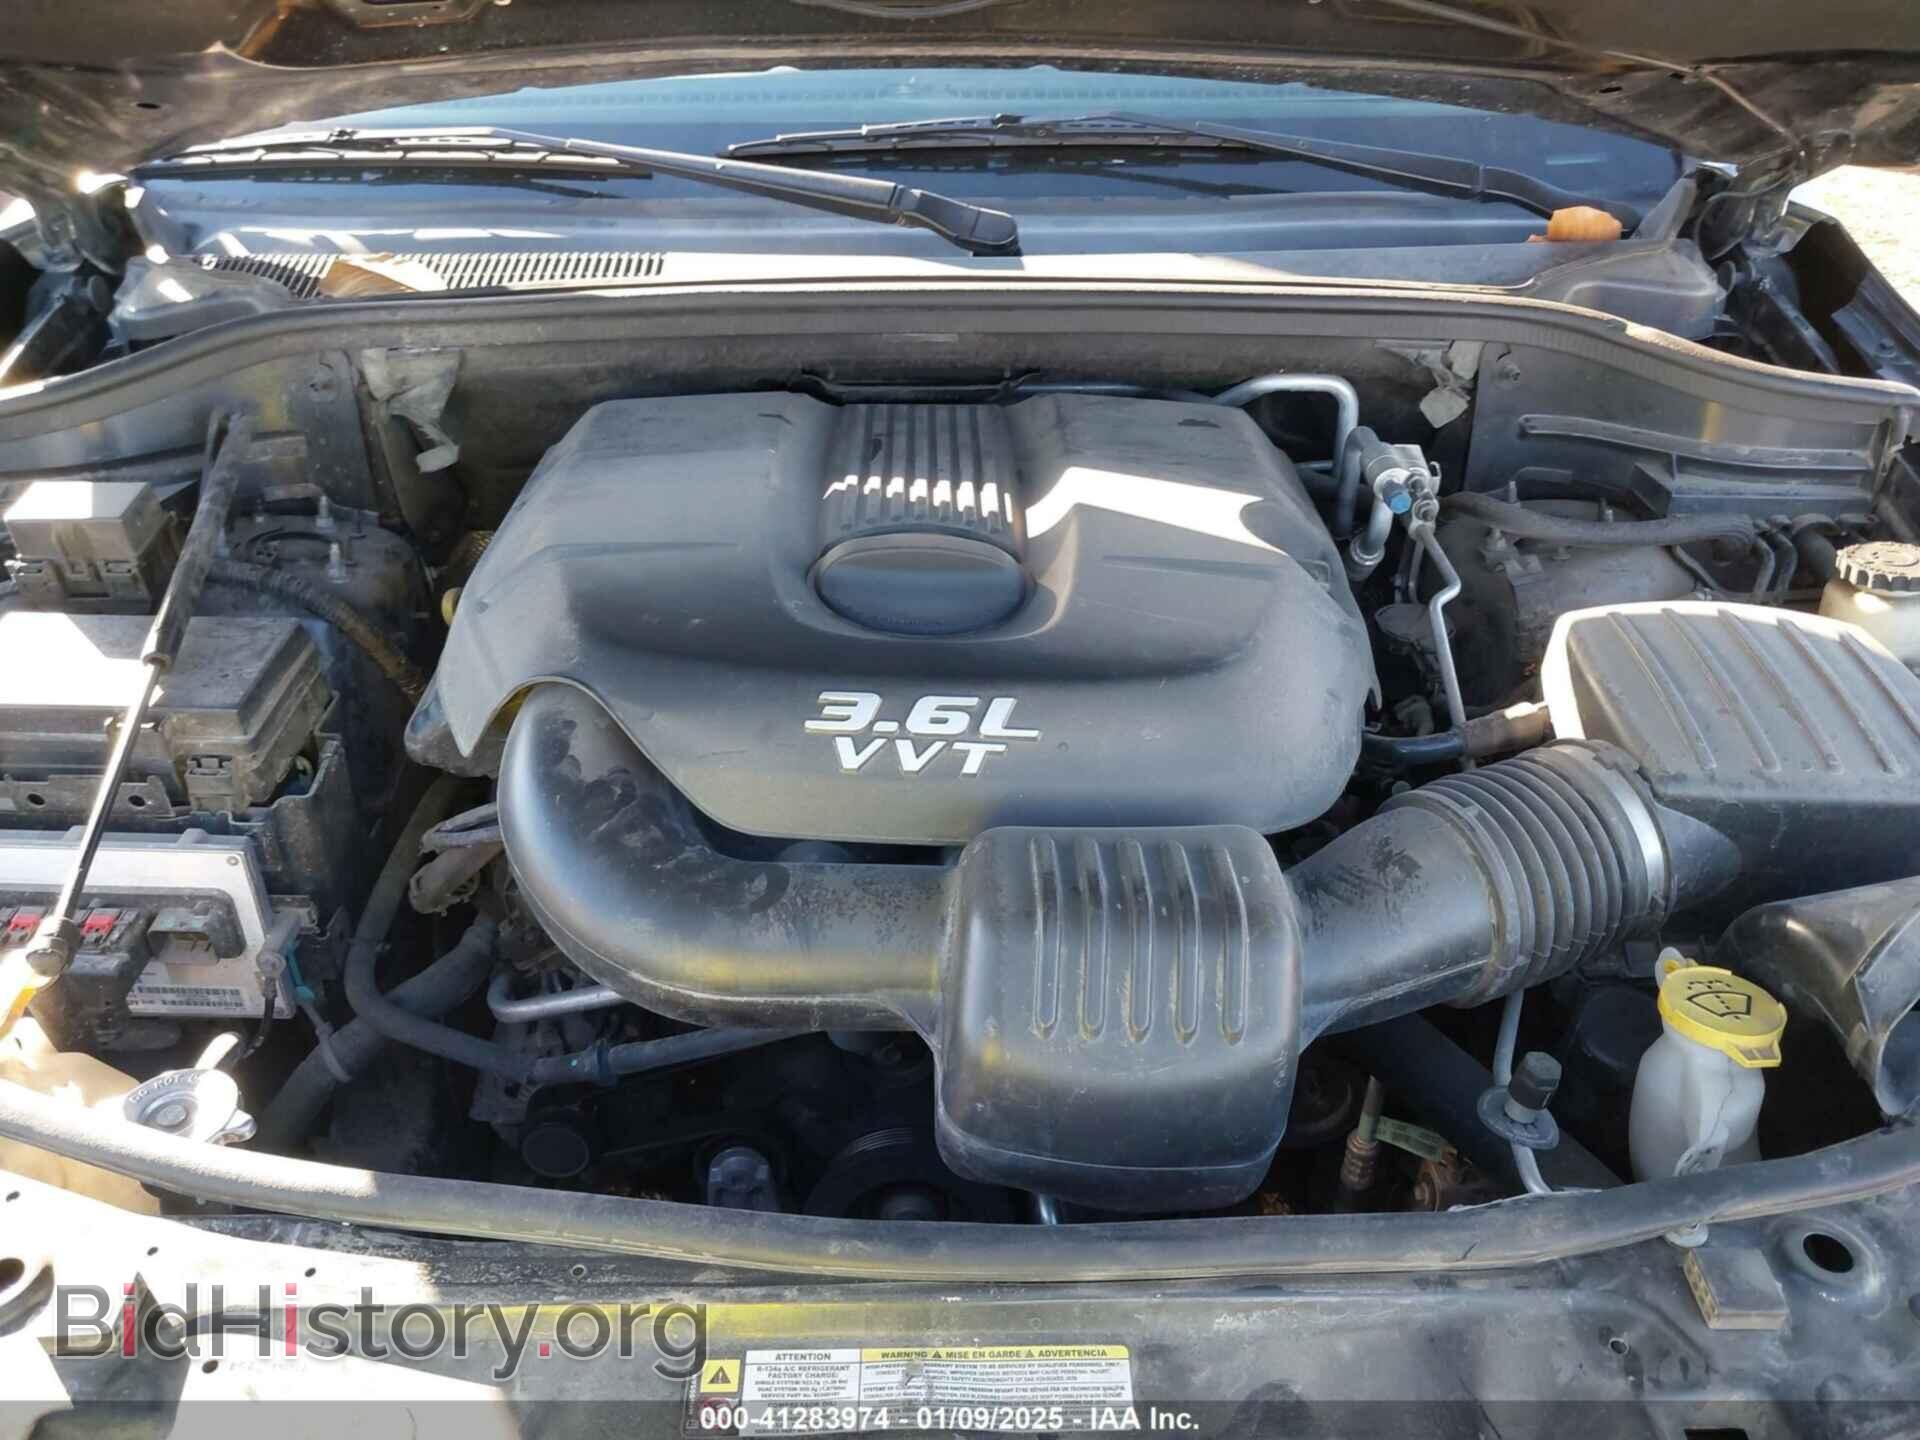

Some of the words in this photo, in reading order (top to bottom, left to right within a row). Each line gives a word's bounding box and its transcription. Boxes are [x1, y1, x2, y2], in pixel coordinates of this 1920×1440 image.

[803, 691, 1041, 740] 3.6L
[834, 736, 1008, 777] VVT
[775, 1353, 832, 1361] ATTENTION
[881, 1351, 928, 1359] WARNING
[946, 1351, 970, 1359] MISE
[972, 1351, 986, 1359] EN
[988, 1350, 1020, 1358] GARDE
[1038, 1349, 1108, 1357] ADVERTENCIA
